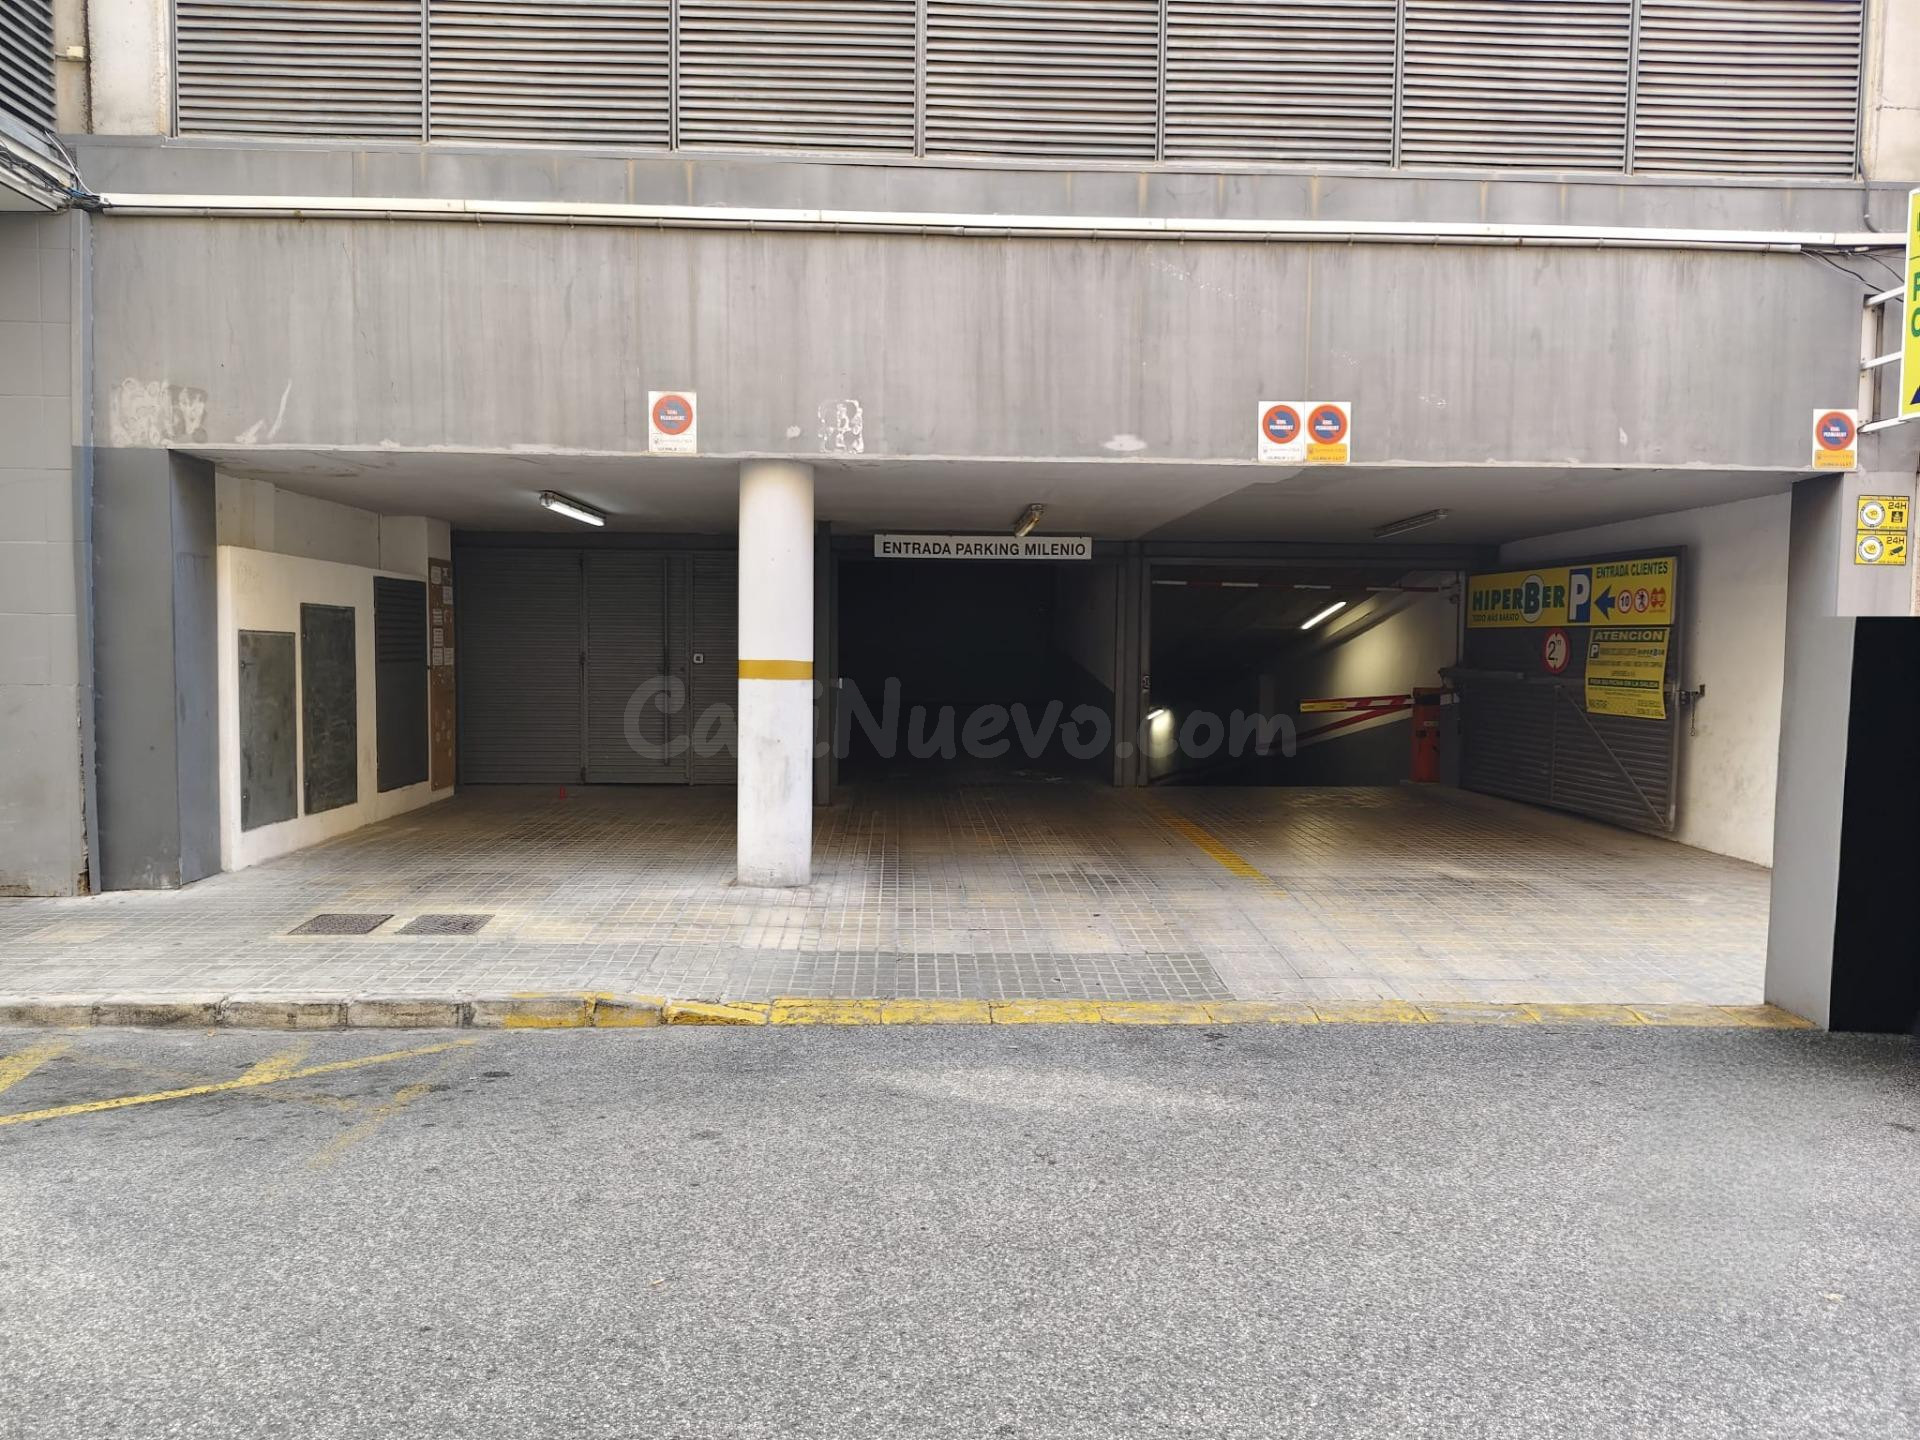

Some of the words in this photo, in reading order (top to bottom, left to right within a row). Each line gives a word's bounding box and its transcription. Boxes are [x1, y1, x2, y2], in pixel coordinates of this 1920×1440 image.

[1888, 501, 1907, 510] 24H
[1886, 536, 1905, 545] 24H
[882, 541, 951, 554] ENTRADA
[955, 542, 1019, 555] PARKING
[1025, 543, 1086, 556] MILENIO
[1596, 563, 1629, 579] ENTRADA
[1630, 561, 1668, 576] CLIENTES
[1620, 595, 1630, 607] 10
[1594, 630, 1663, 641] ATENCION
